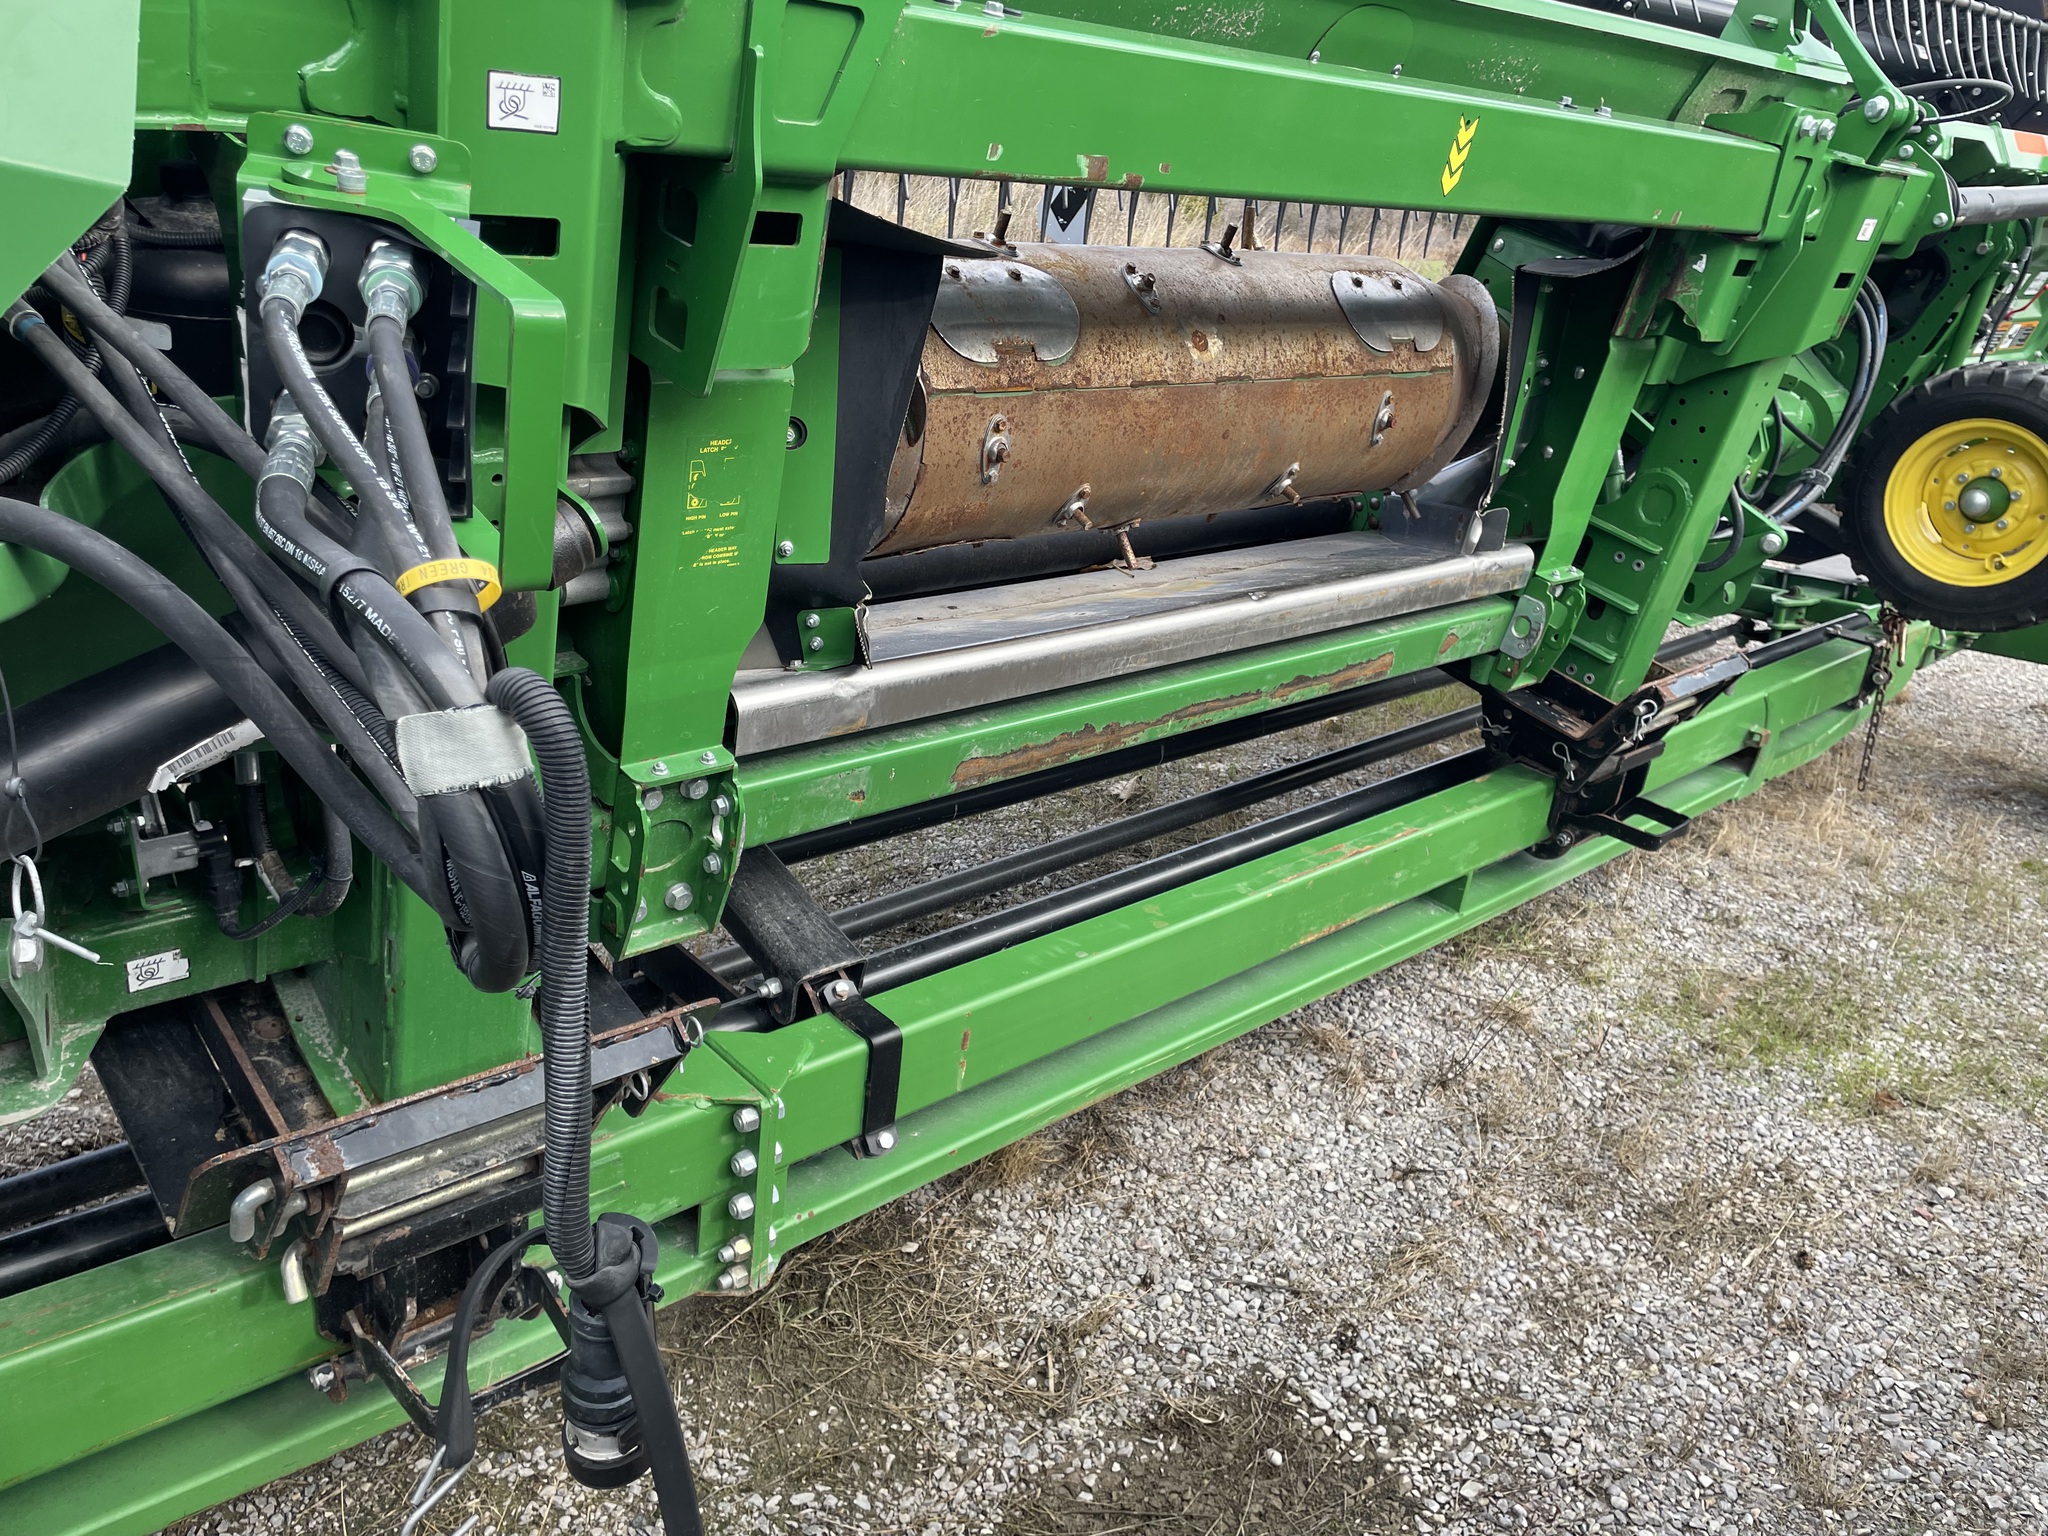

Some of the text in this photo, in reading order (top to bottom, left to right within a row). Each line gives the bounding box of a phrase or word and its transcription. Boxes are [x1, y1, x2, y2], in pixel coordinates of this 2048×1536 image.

[699, 446, 719, 454] LATCH
[283, 540, 296, 556] DN
[293, 547, 305, 561] 16
[302, 553, 328, 577] MSHA
[418, 561, 469, 581] GREEN
[364, 607, 399, 647] MADE
[445, 859, 460, 895] MSHA
